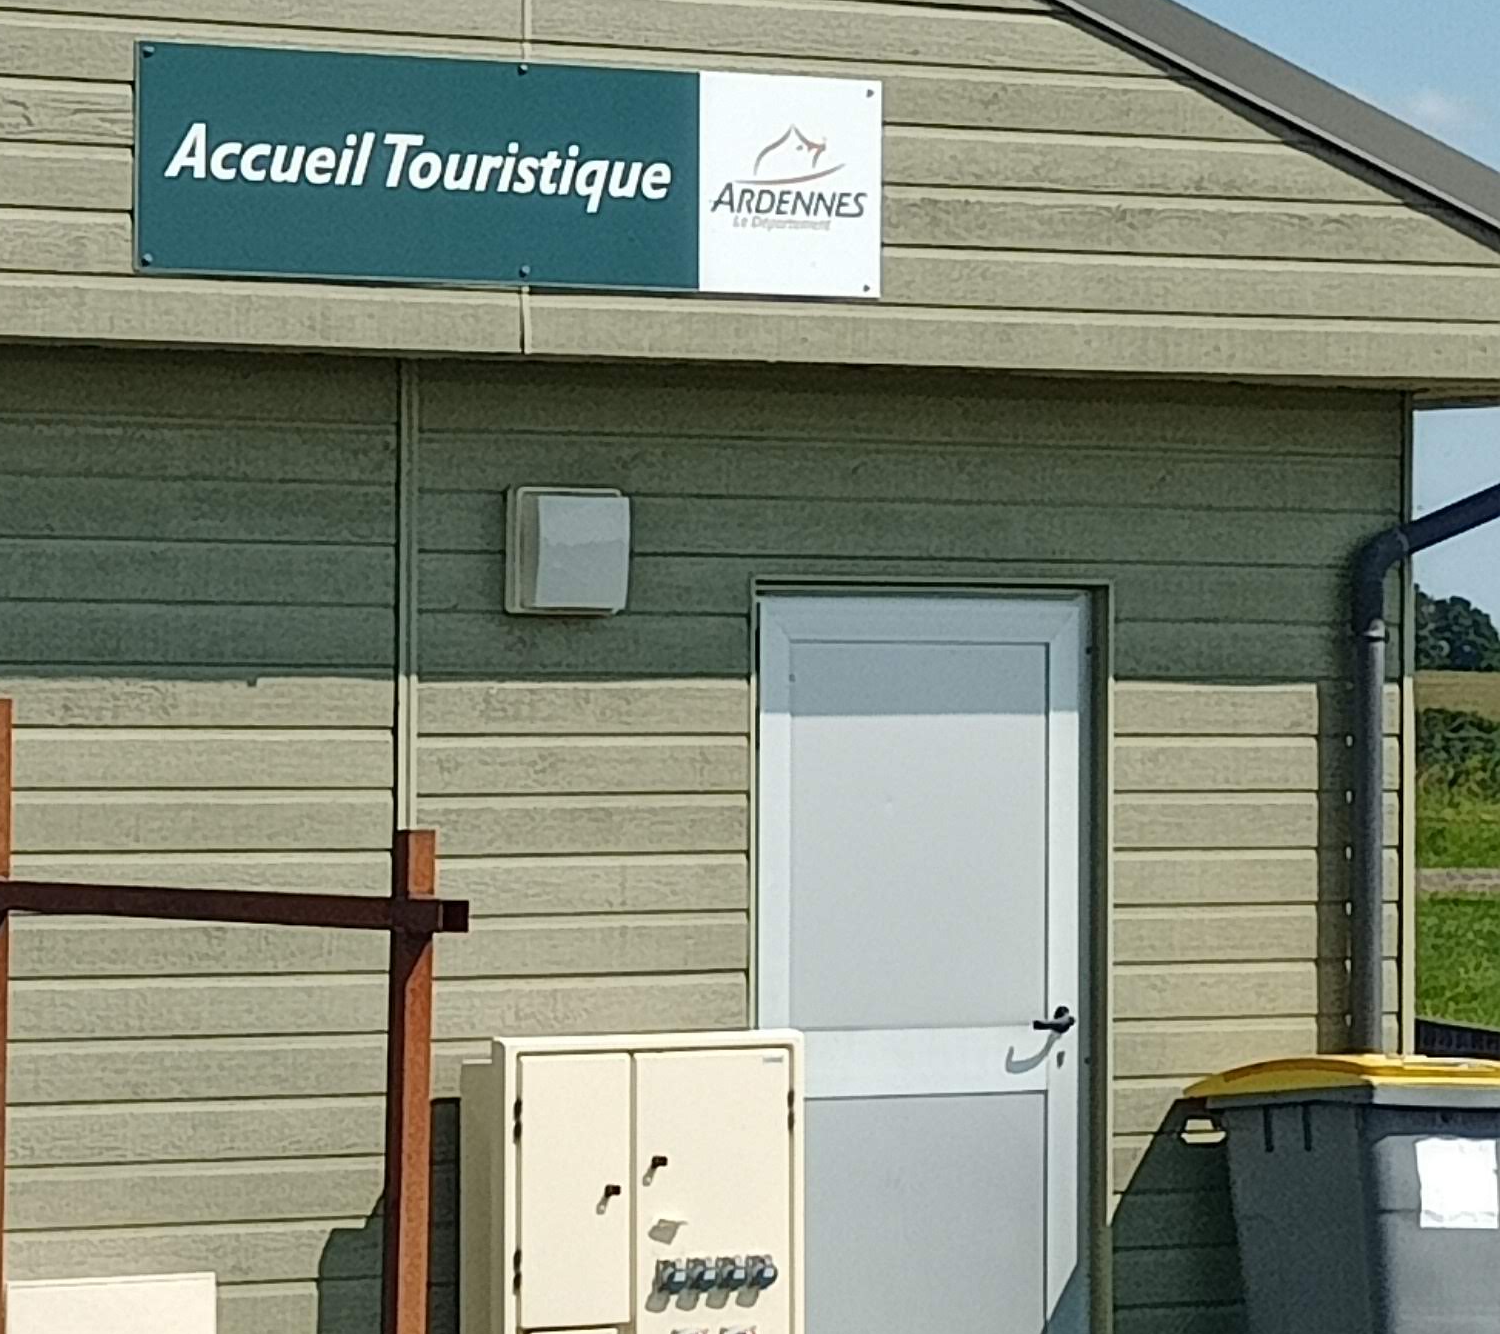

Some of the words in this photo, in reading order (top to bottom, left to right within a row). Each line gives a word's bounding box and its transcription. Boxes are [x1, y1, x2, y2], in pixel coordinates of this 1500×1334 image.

[163, 122, 376, 186] Accueil
[383, 132, 672, 214] Touristique
[710, 182, 868, 218] ARDENNES
